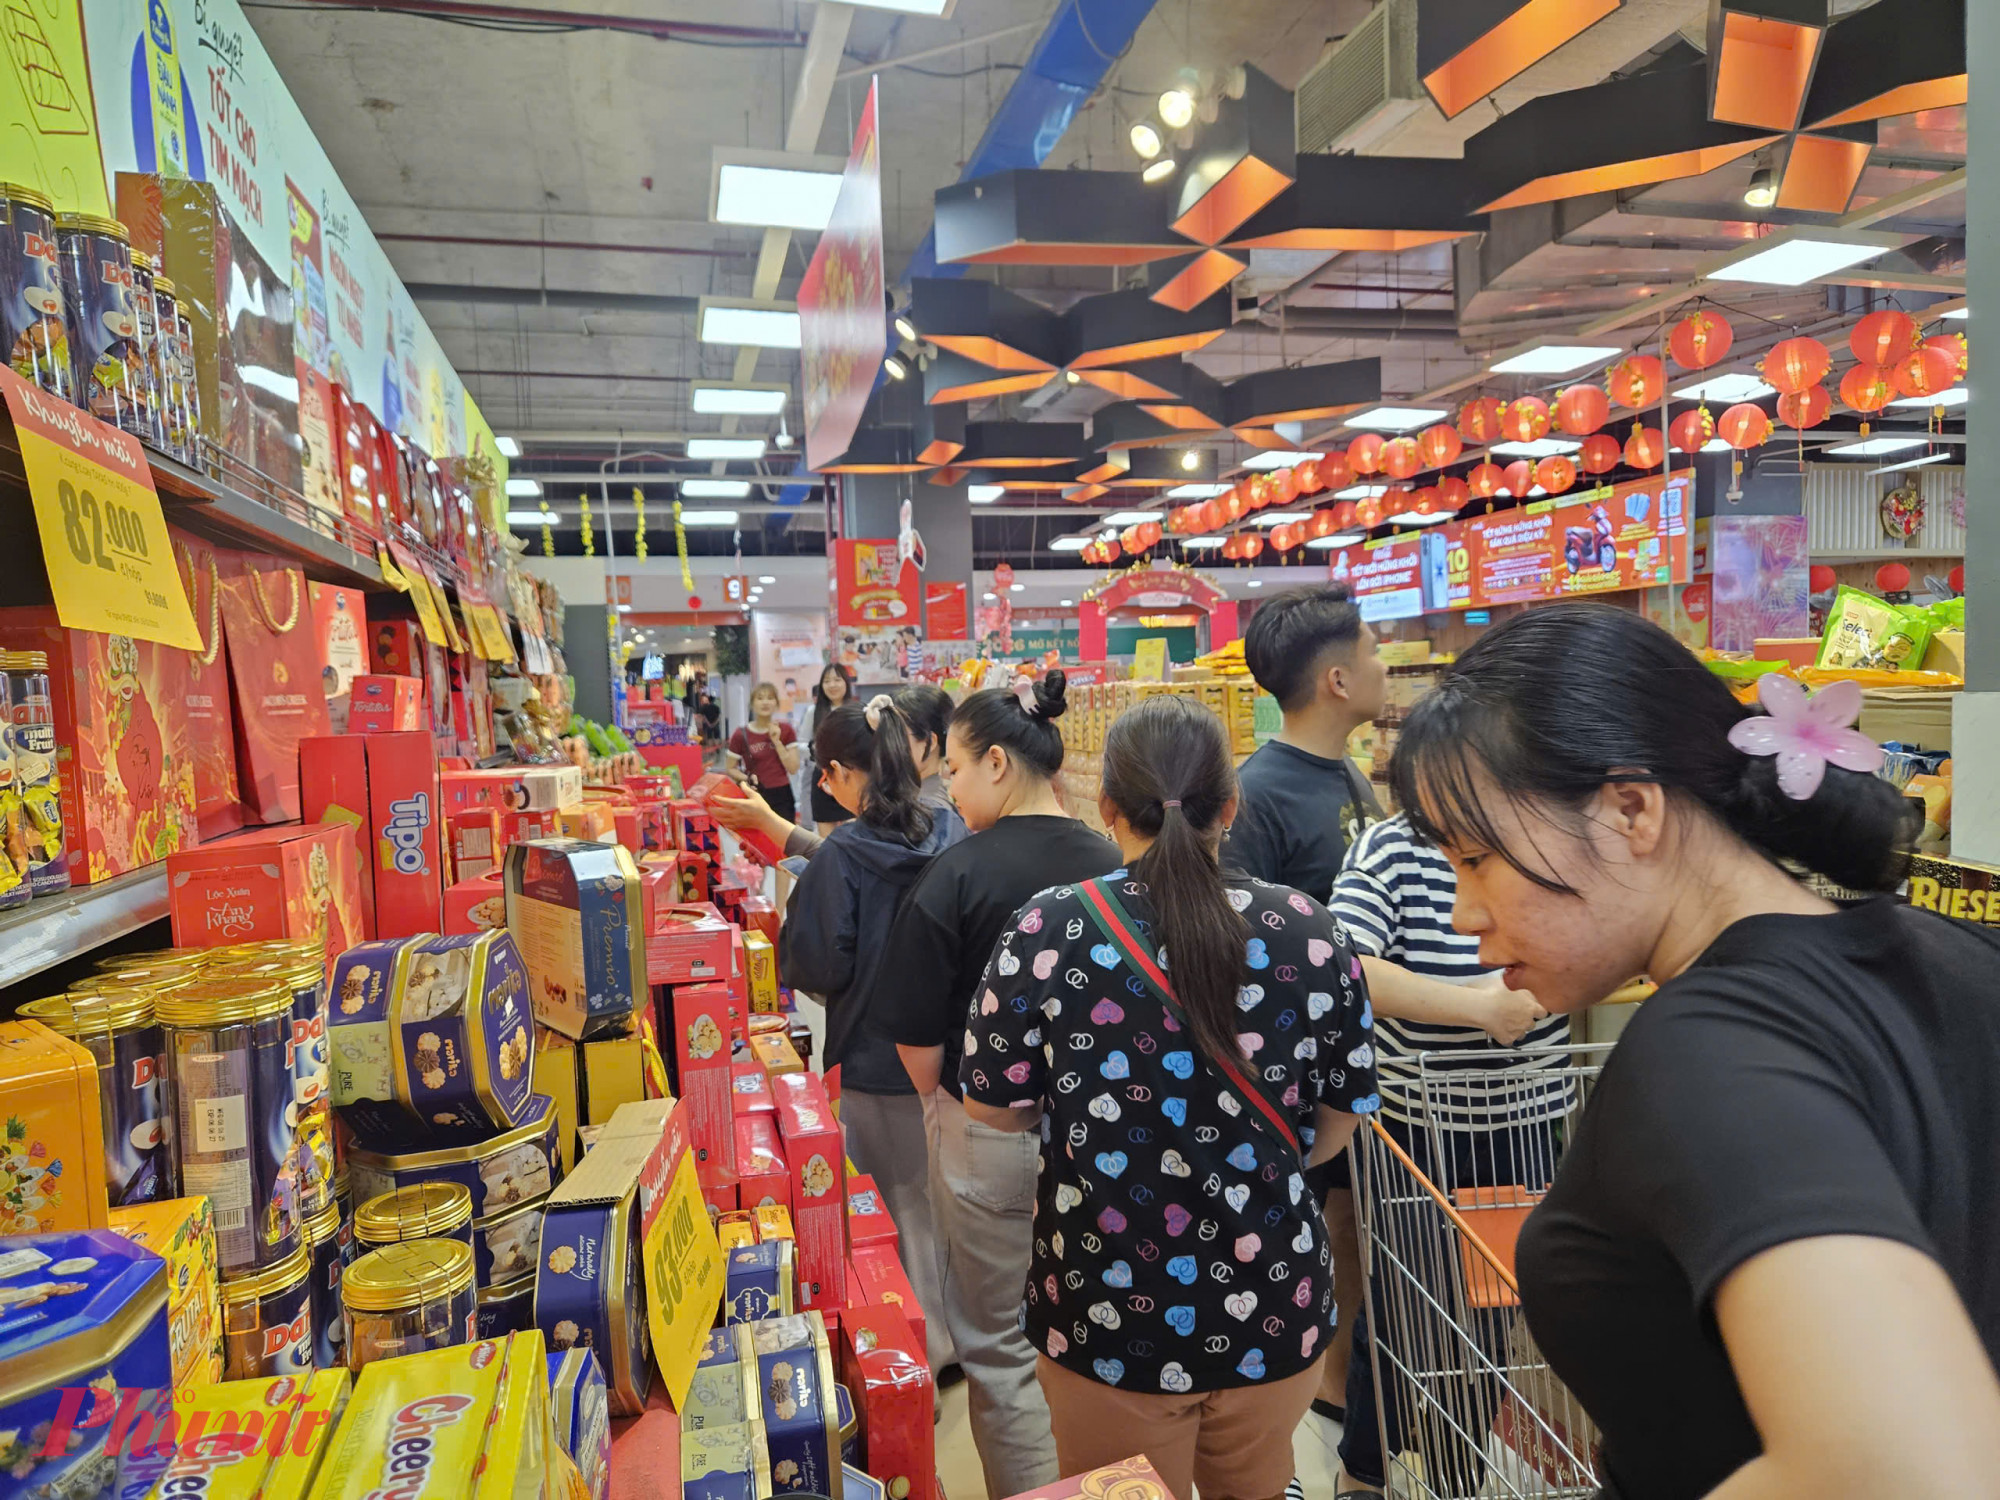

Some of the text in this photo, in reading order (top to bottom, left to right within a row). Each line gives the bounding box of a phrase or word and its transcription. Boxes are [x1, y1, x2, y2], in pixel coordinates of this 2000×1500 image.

[207, 65, 257, 167] TỐT CHO
[207, 121, 264, 229] TIM MẠCH
[728, 579, 741, 599] 9
[1446, 547, 1470, 573] 10
[382, 791, 430, 875] Tipo
[341, 1071, 354, 1092] PURE
[653, 1194, 695, 1326] 93.000
[168, 1287, 205, 1357] FRUTAL
[693, 1415, 705, 1430] PUR
